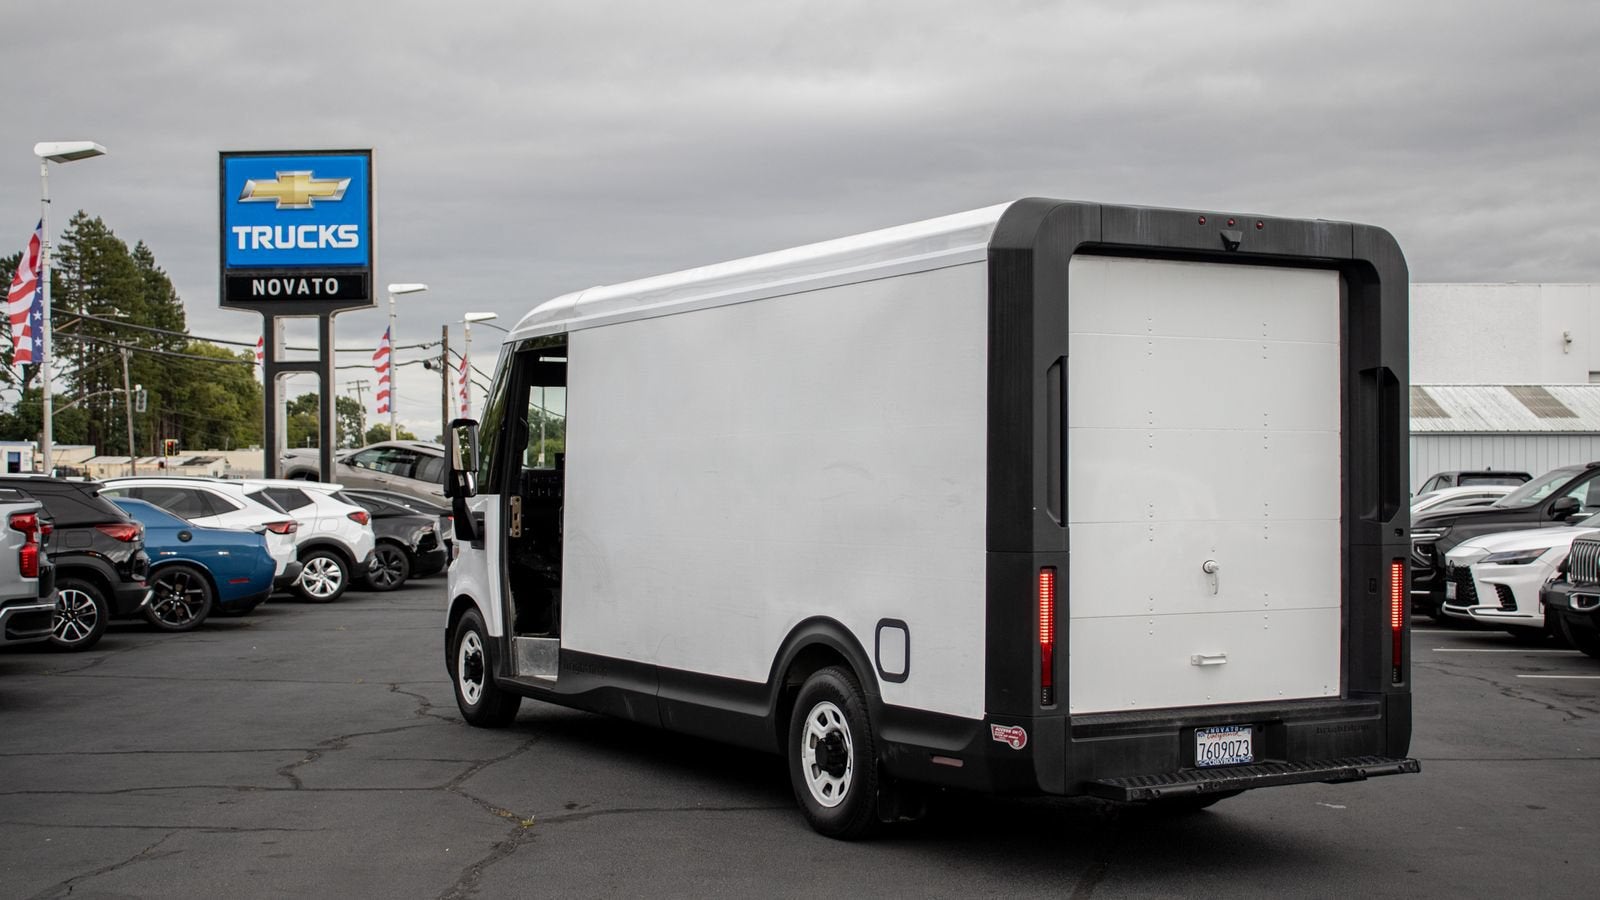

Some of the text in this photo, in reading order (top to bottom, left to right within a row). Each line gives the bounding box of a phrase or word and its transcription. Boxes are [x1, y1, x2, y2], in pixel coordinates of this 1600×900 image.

[232, 224, 359, 250] TRUCKS
[252, 277, 339, 296] NOVATO
[1199, 739, 1249, 760] 76090Z3
[1208, 757, 1241, 766] CHEVROLET
